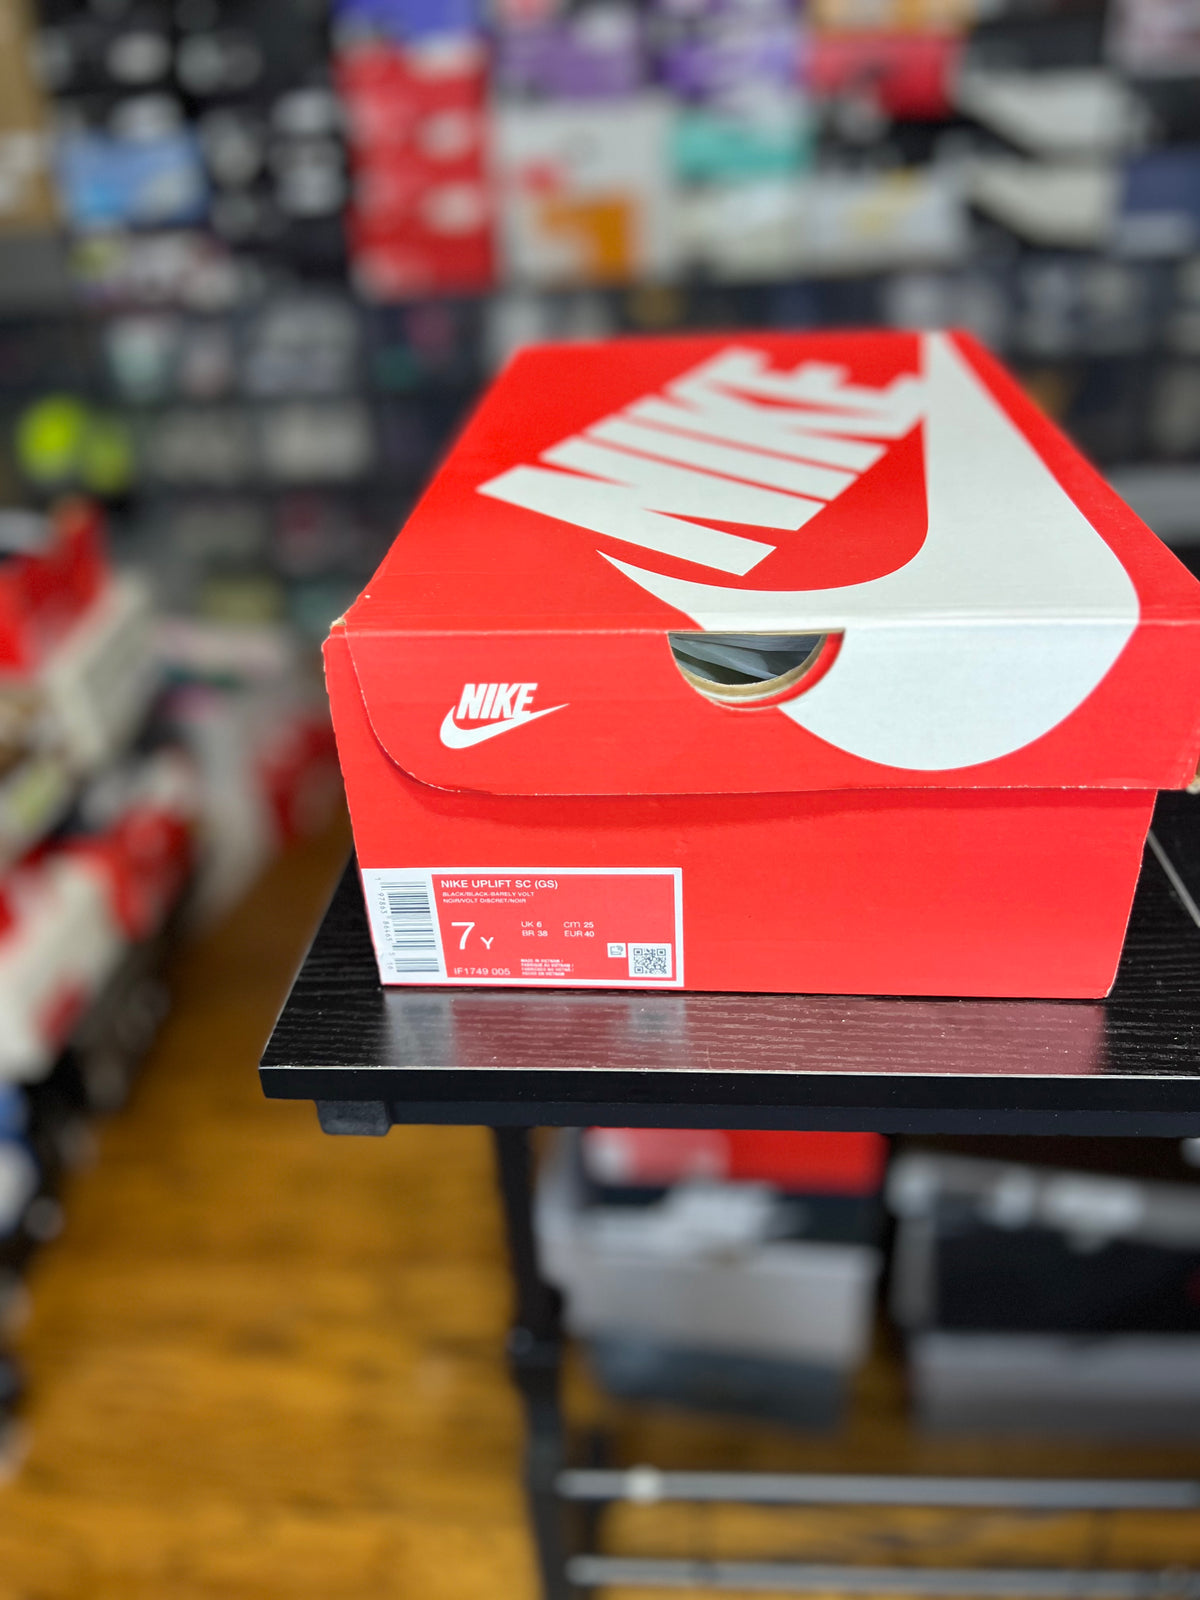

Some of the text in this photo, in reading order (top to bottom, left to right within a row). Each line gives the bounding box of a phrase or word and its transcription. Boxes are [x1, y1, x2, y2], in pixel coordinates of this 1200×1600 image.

[475, 346, 922, 577] NIKE
[456, 683, 538, 719] NIKE
[441, 879, 558, 890] NIKE UPLIFT SC (GS)
[451, 921, 494, 950] 7 Y
[584, 930, 595, 938] 40
[454, 967, 489, 976] IF1749
[491, 967, 511, 976] 005
